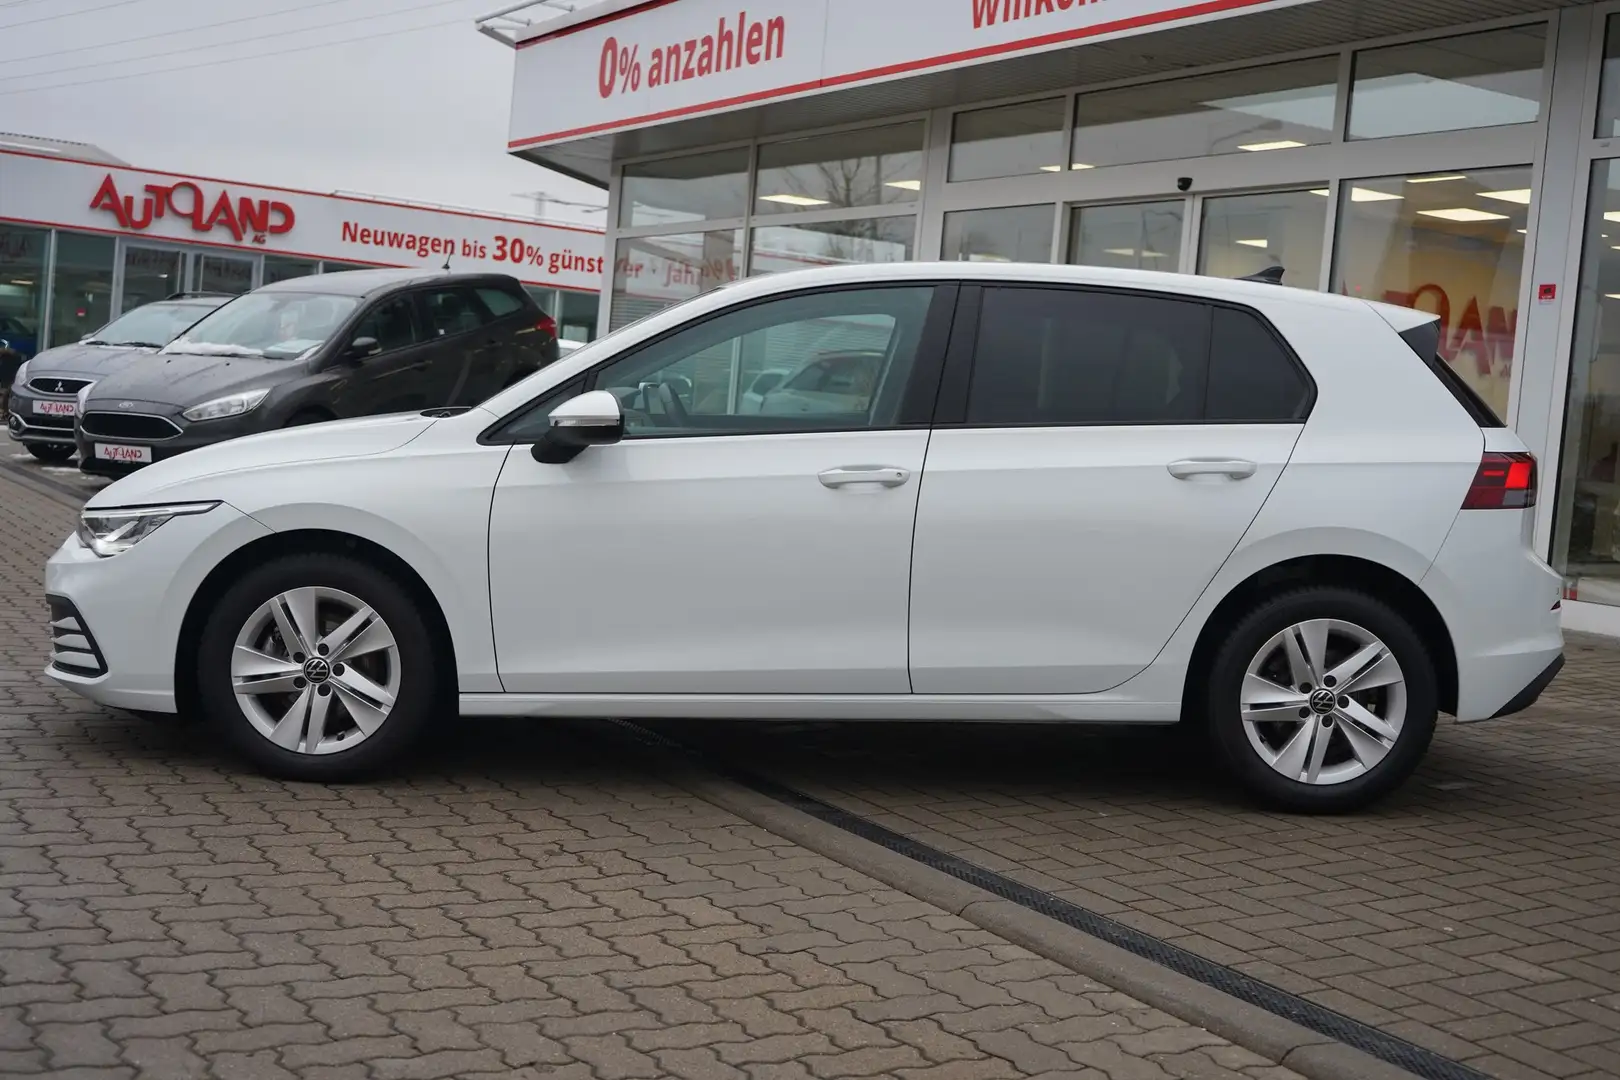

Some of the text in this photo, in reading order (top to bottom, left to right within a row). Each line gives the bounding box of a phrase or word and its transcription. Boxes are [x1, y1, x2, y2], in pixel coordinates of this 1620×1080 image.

[598, 11, 785, 99] 0% anzahlen
[252, 233, 267, 245] AG
[341, 220, 455, 258] Neuwagen
[461, 238, 487, 260] bis
[492, 235, 544, 267] 30%
